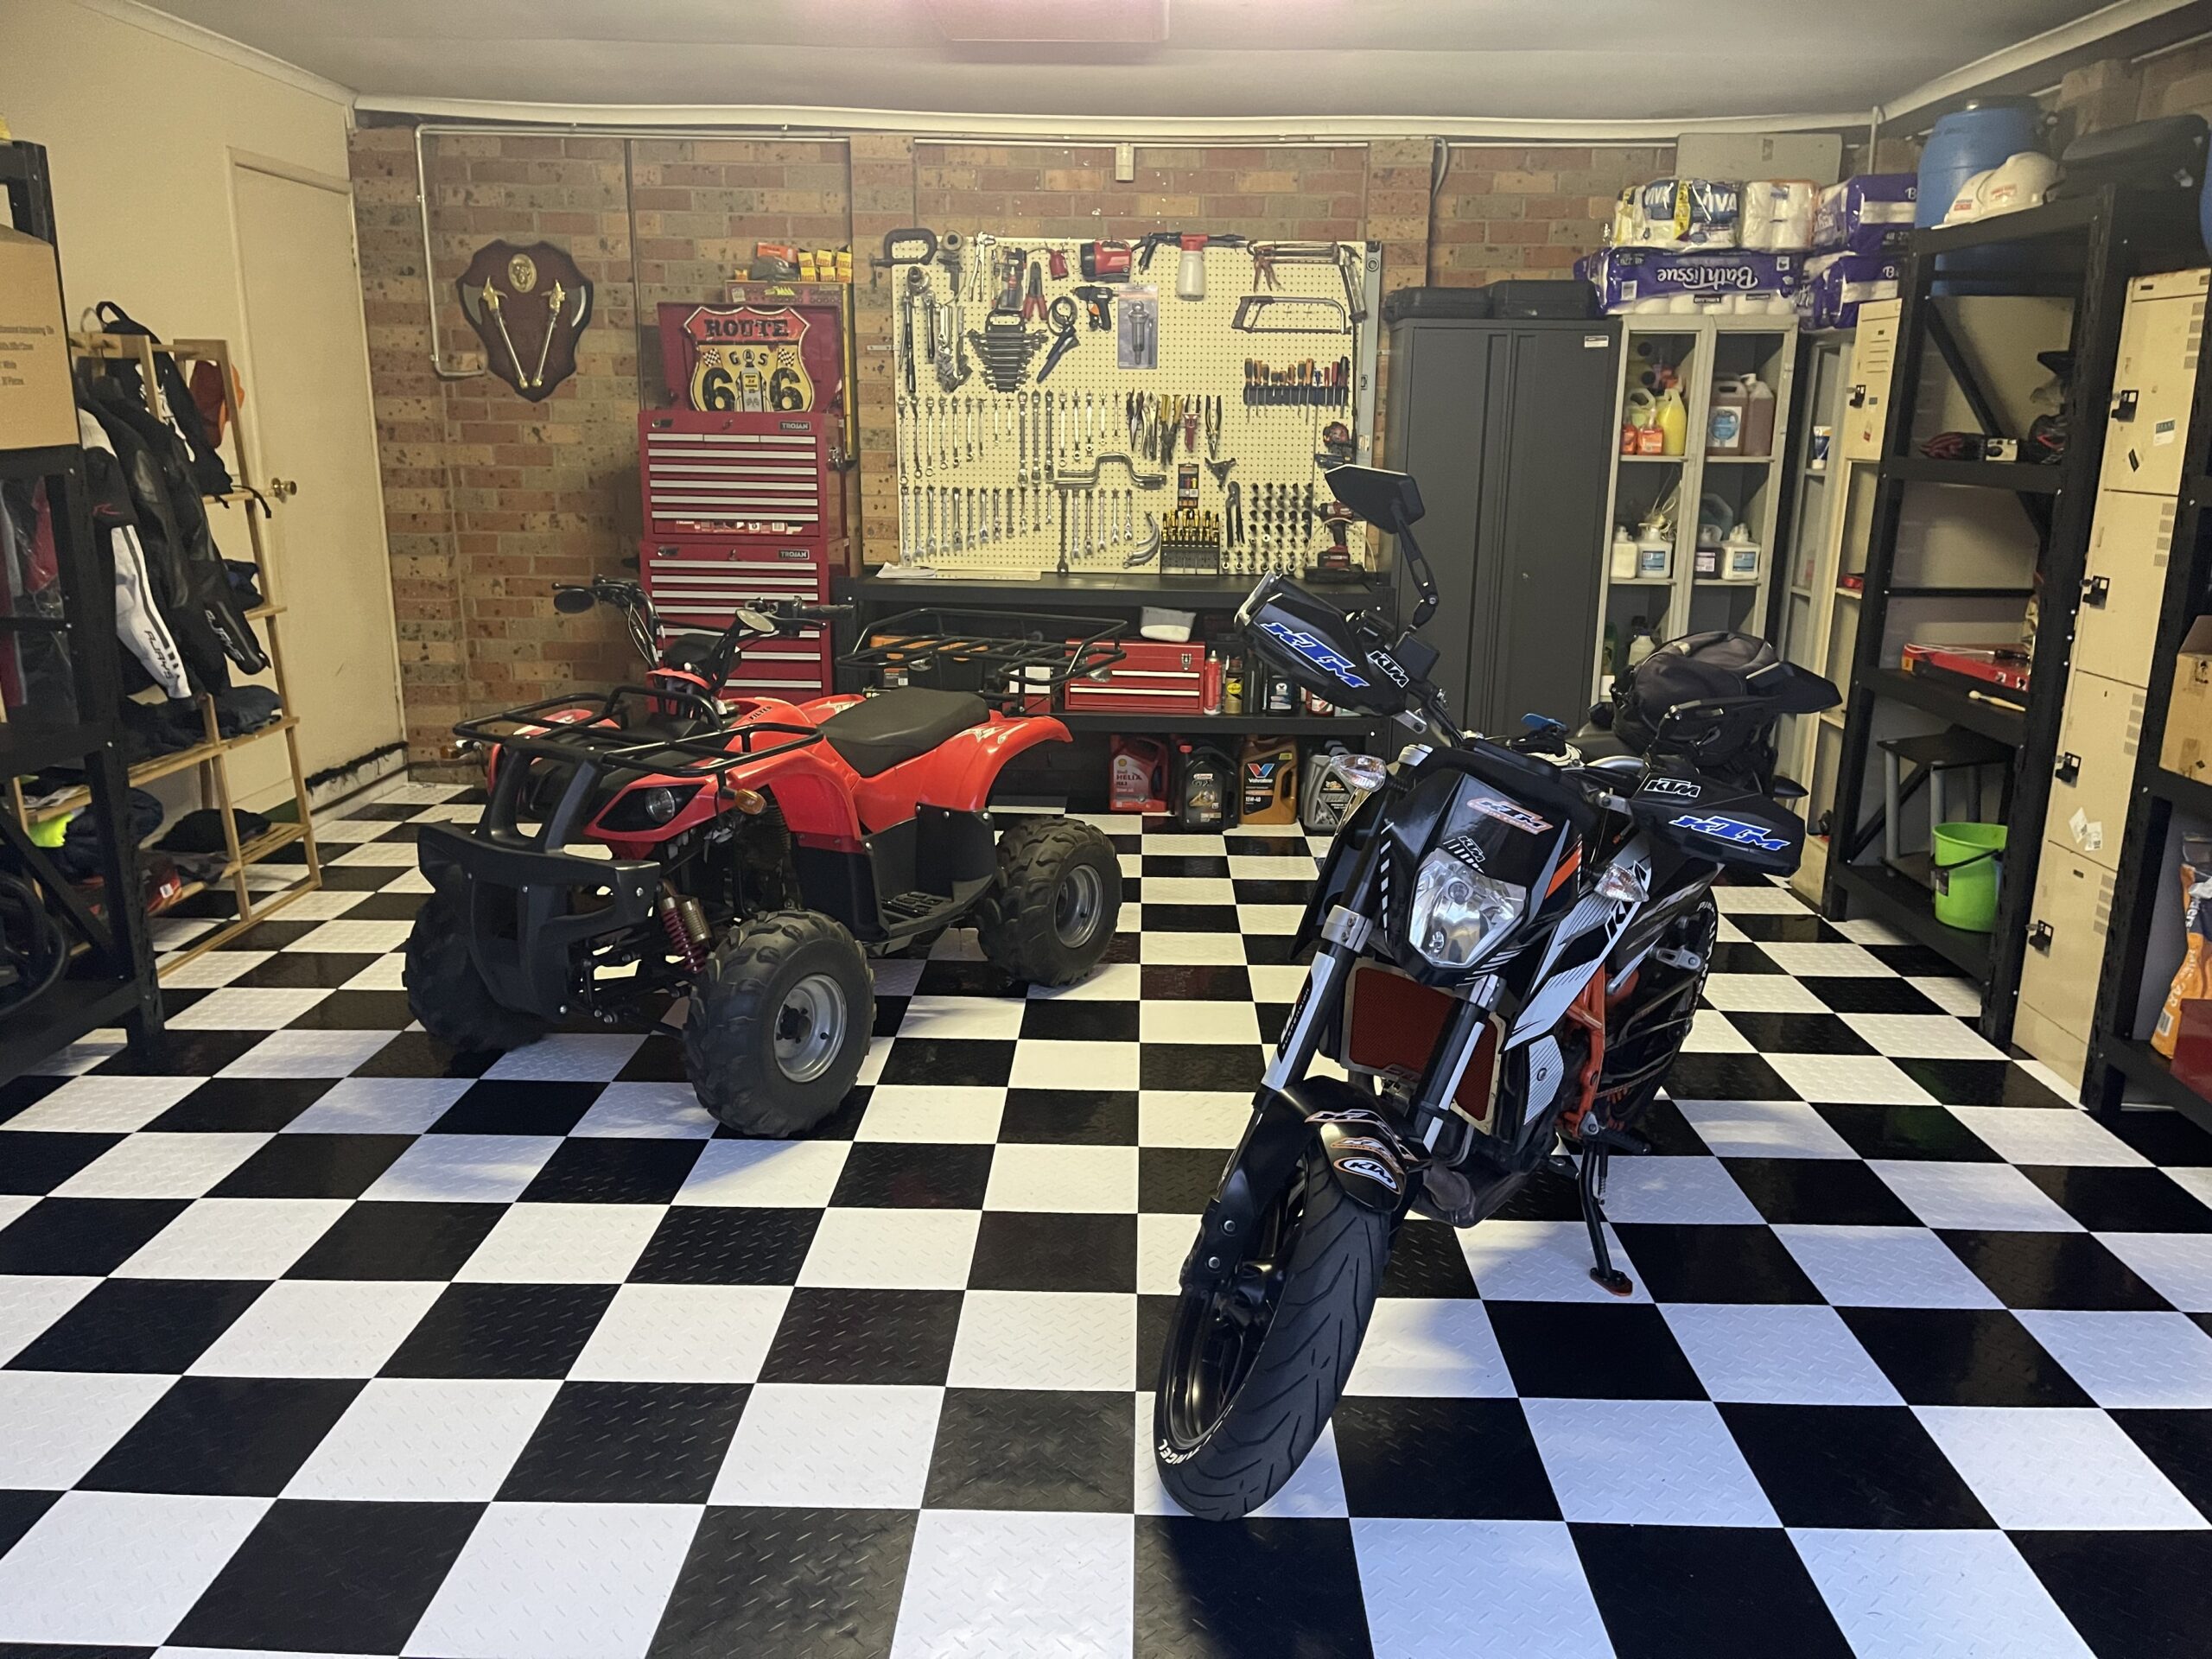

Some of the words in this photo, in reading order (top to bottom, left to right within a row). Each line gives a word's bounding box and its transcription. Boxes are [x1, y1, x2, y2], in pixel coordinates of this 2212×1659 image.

[703, 318, 790, 338] ROUTE
[780, 422, 810, 431] TROJAN
[779, 550, 809, 558] TROJAN
[1260, 622, 1371, 688] KTM
[1368, 650, 1410, 689] KTM
[1643, 778, 1701, 798] KTM
[1475, 799, 1548, 830] KTM
[1668, 814, 1792, 852] KTM
[1457, 835, 1486, 863] KTM
[1348, 1161, 1395, 1185] KTM
